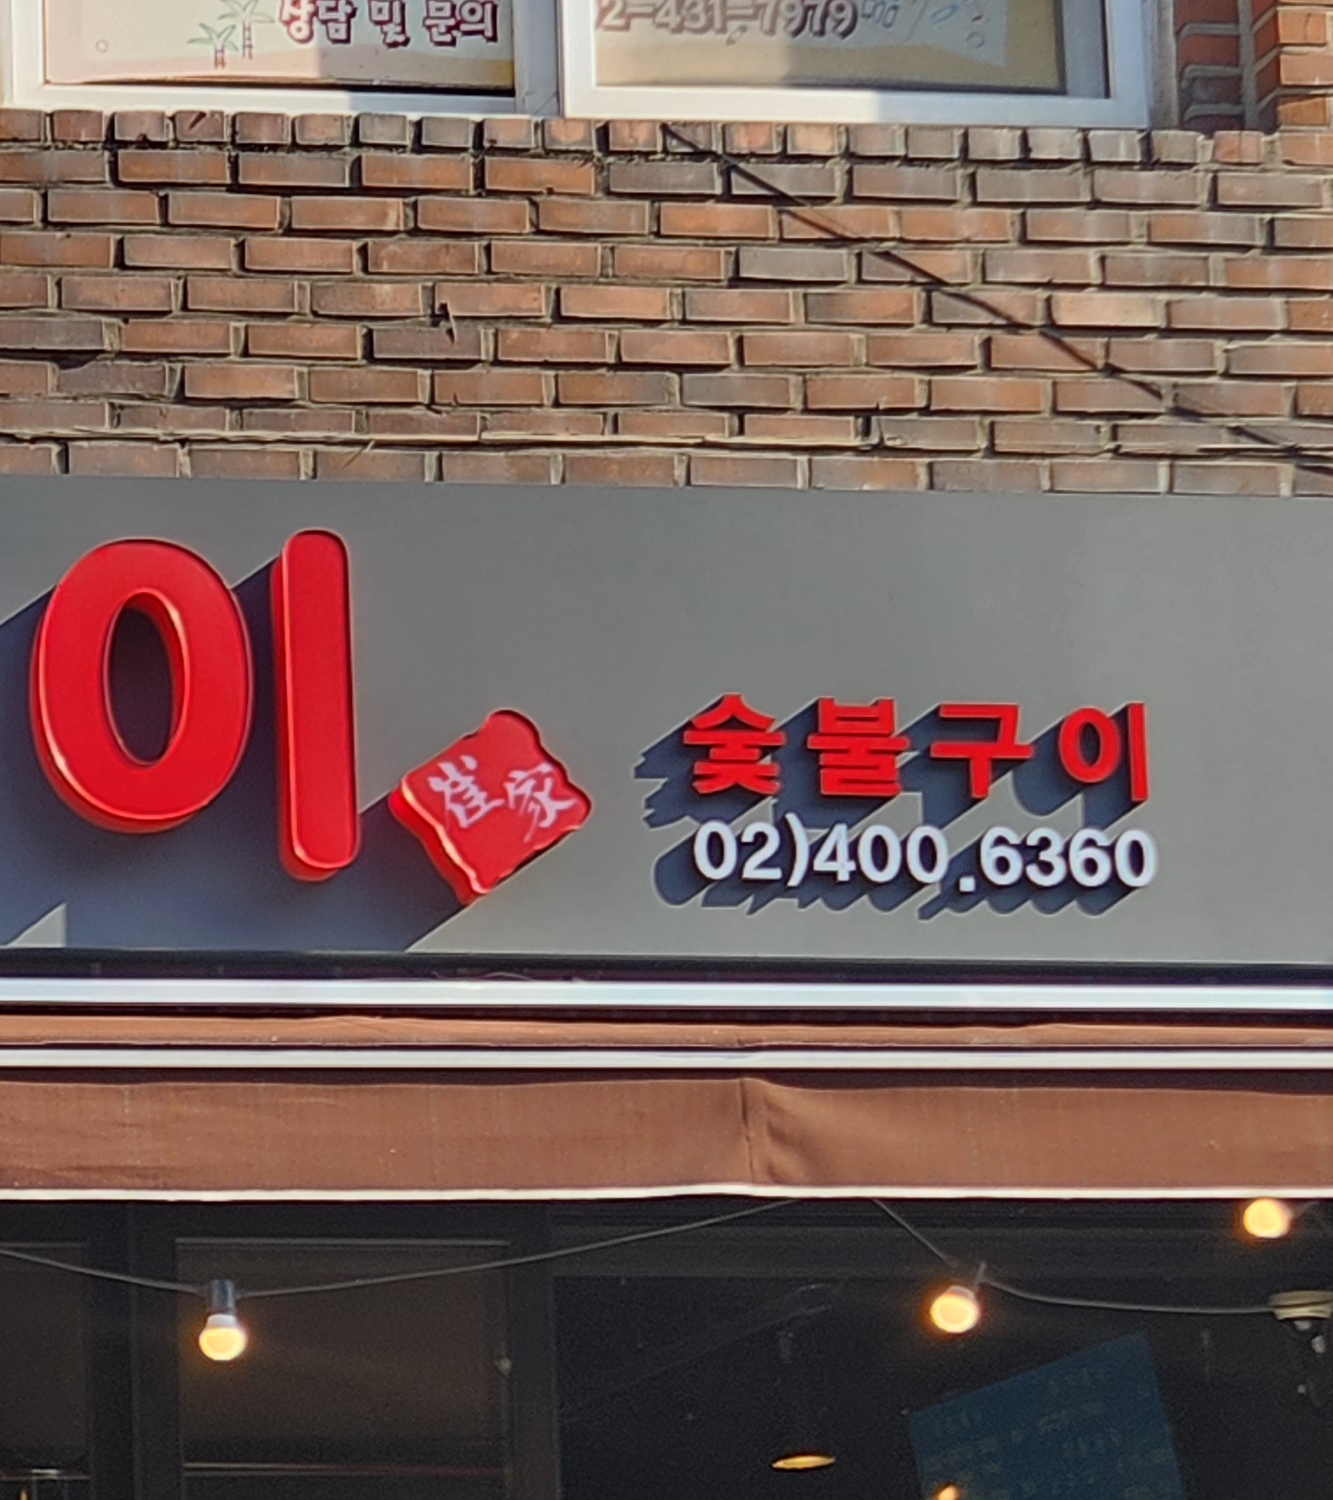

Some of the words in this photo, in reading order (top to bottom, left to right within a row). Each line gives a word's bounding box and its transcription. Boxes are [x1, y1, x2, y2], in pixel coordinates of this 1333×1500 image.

[423, 0, 499, 47] 문의
[683, 693, 1151, 802] 숯불구이
[693, 811, 1157, 892] 02)400.6360
